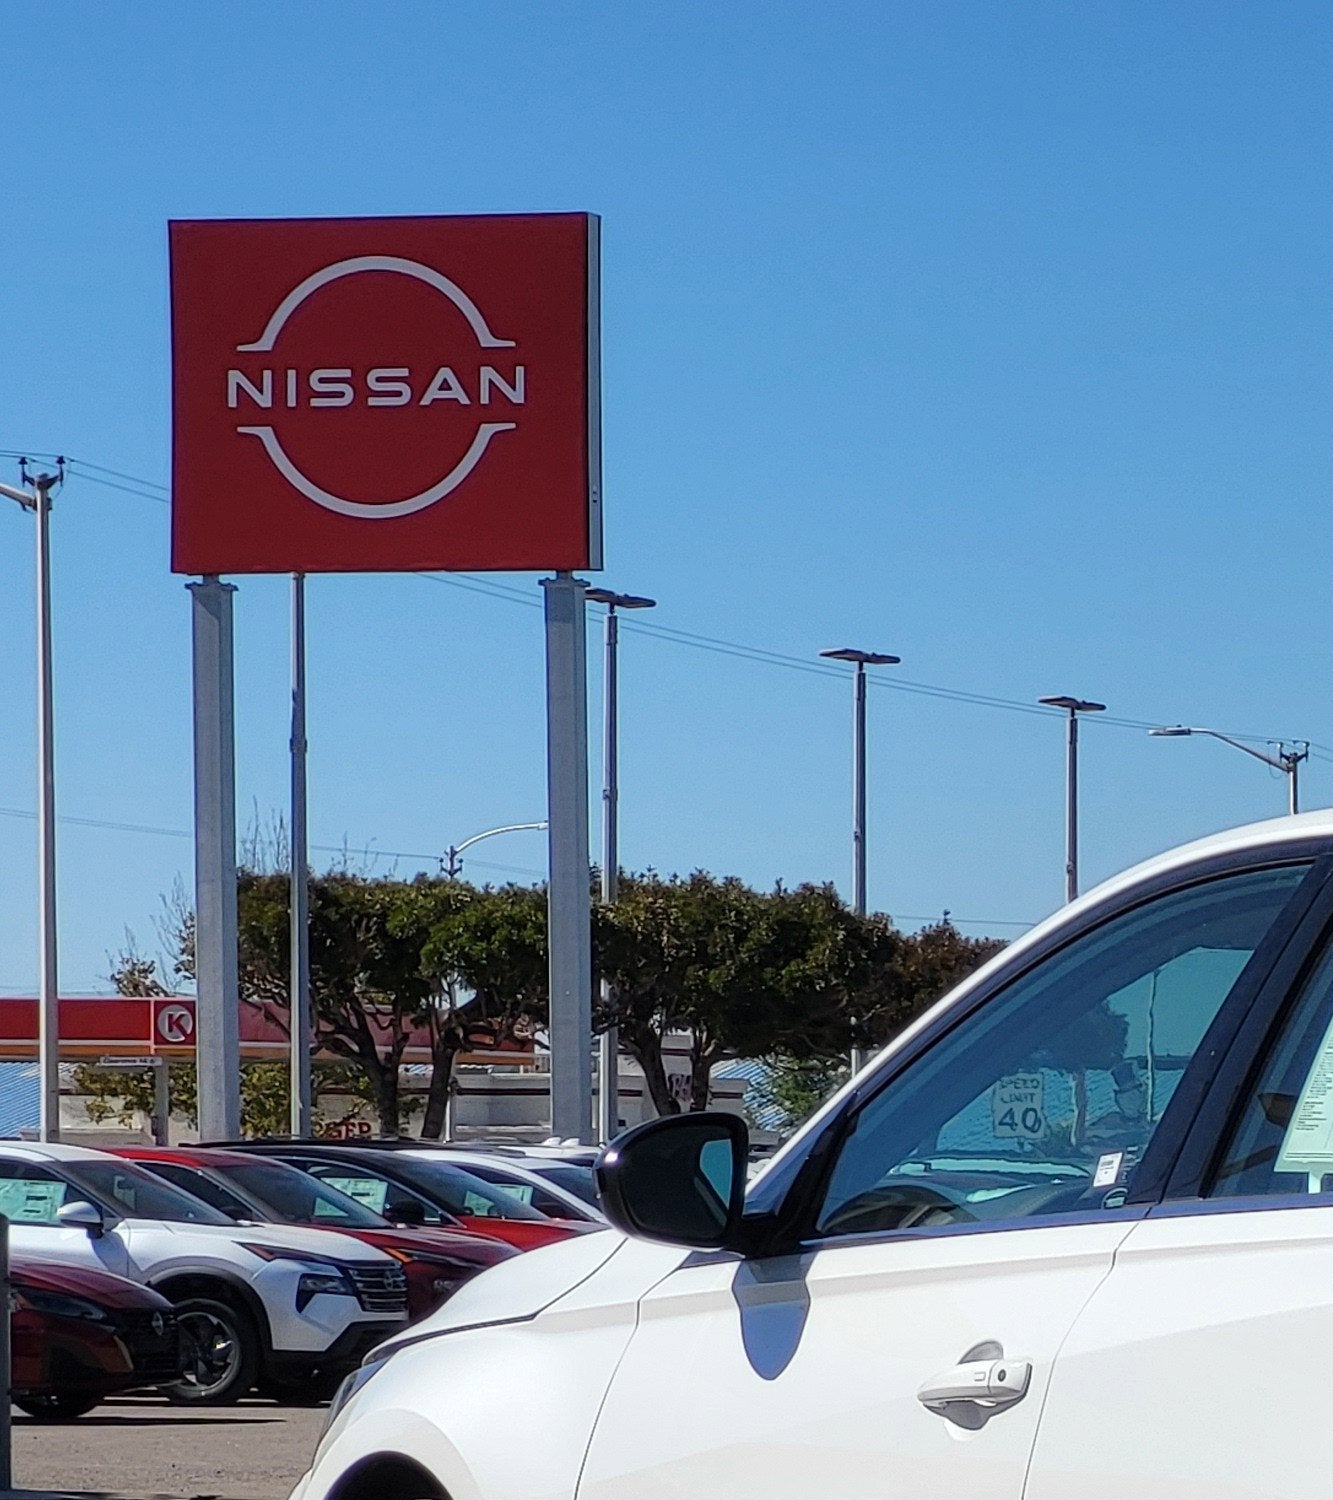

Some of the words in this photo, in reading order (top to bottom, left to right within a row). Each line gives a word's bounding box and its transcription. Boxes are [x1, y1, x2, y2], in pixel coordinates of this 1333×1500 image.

[228, 366, 525, 408] NISSAN
[167, 1012, 191, 1037] K
[998, 1107, 1042, 1133] 40
